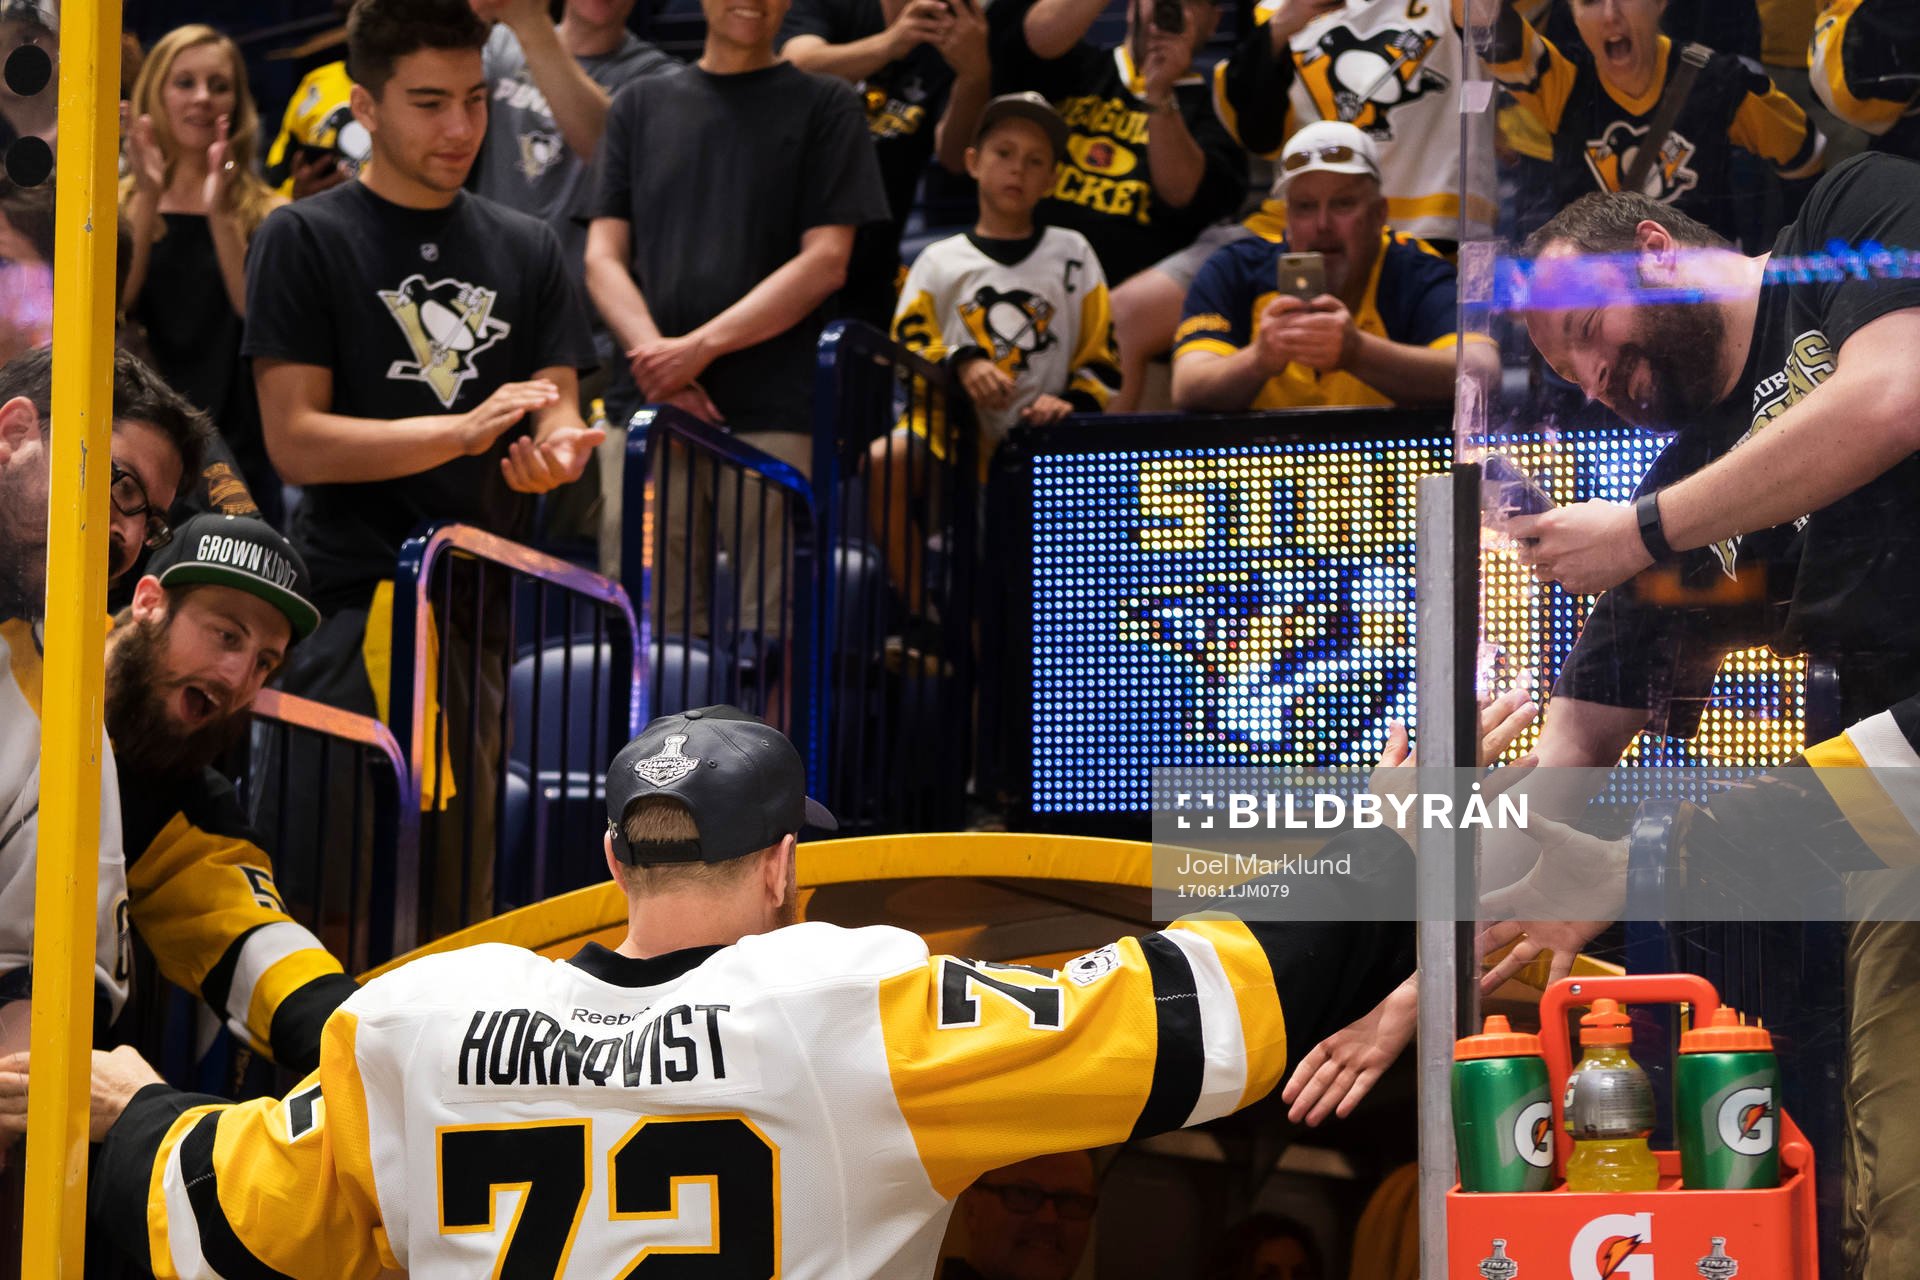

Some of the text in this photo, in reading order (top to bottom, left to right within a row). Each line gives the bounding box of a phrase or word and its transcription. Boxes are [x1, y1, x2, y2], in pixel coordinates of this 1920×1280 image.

[196, 534, 263, 571] GROWN
[639, 760, 694, 769] CHAMPIONS
[571, 1008, 651, 1026] Reeb
[458, 1004, 730, 1088] HORNQVIST
[1717, 1087, 1774, 1156] G
[436, 1112, 781, 1280] 72
